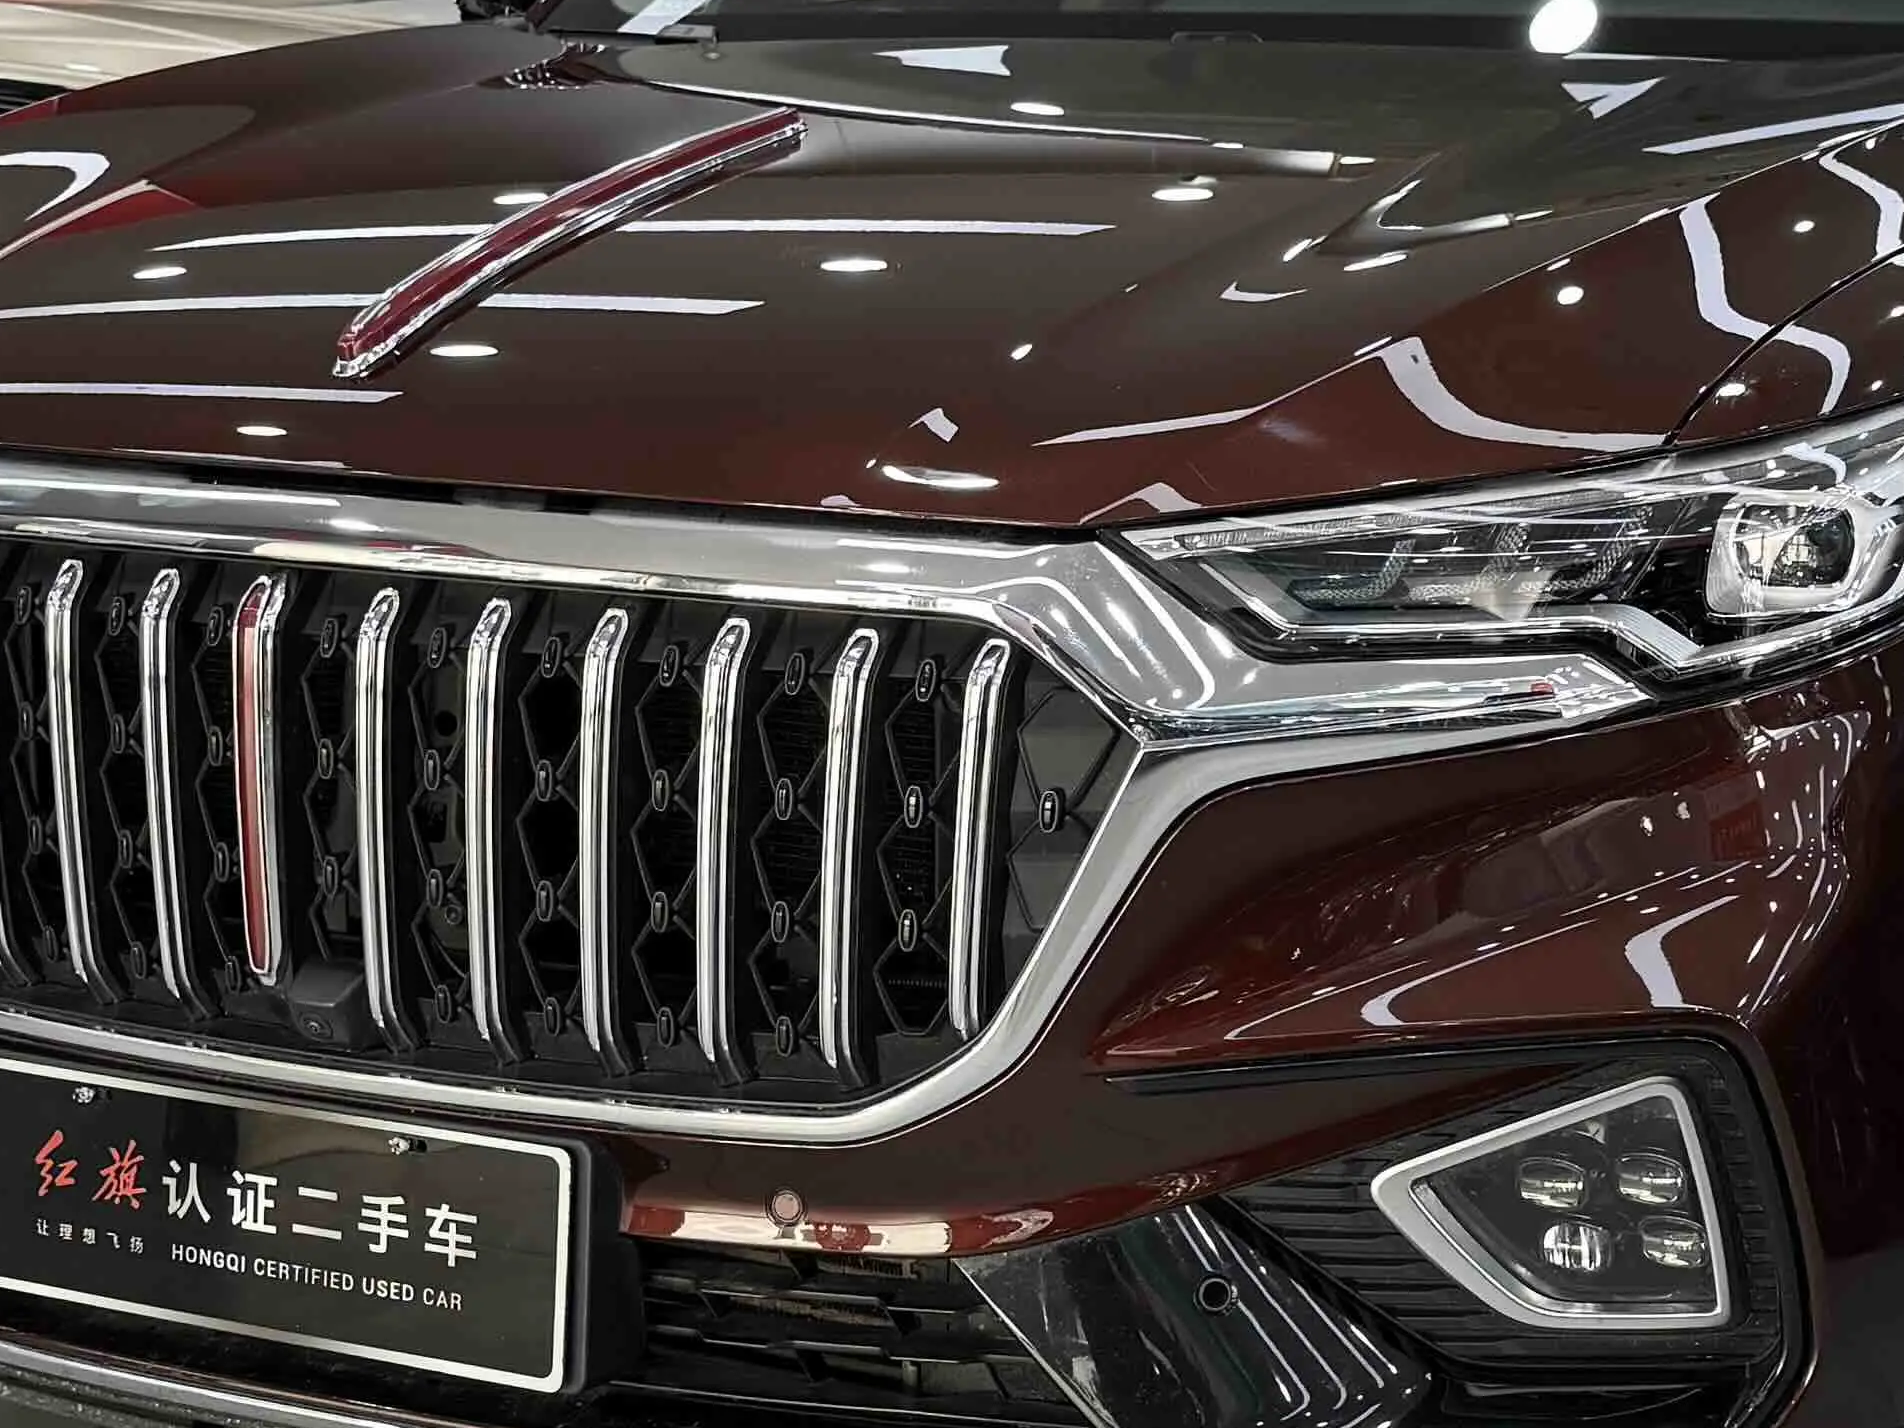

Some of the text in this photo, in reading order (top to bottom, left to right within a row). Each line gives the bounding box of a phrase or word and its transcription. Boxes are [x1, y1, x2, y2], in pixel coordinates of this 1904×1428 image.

[36, 1217, 145, 1255] 让理想飞扬
[171, 1243, 463, 1312] HONGQI CERTIFIED USED CAR
